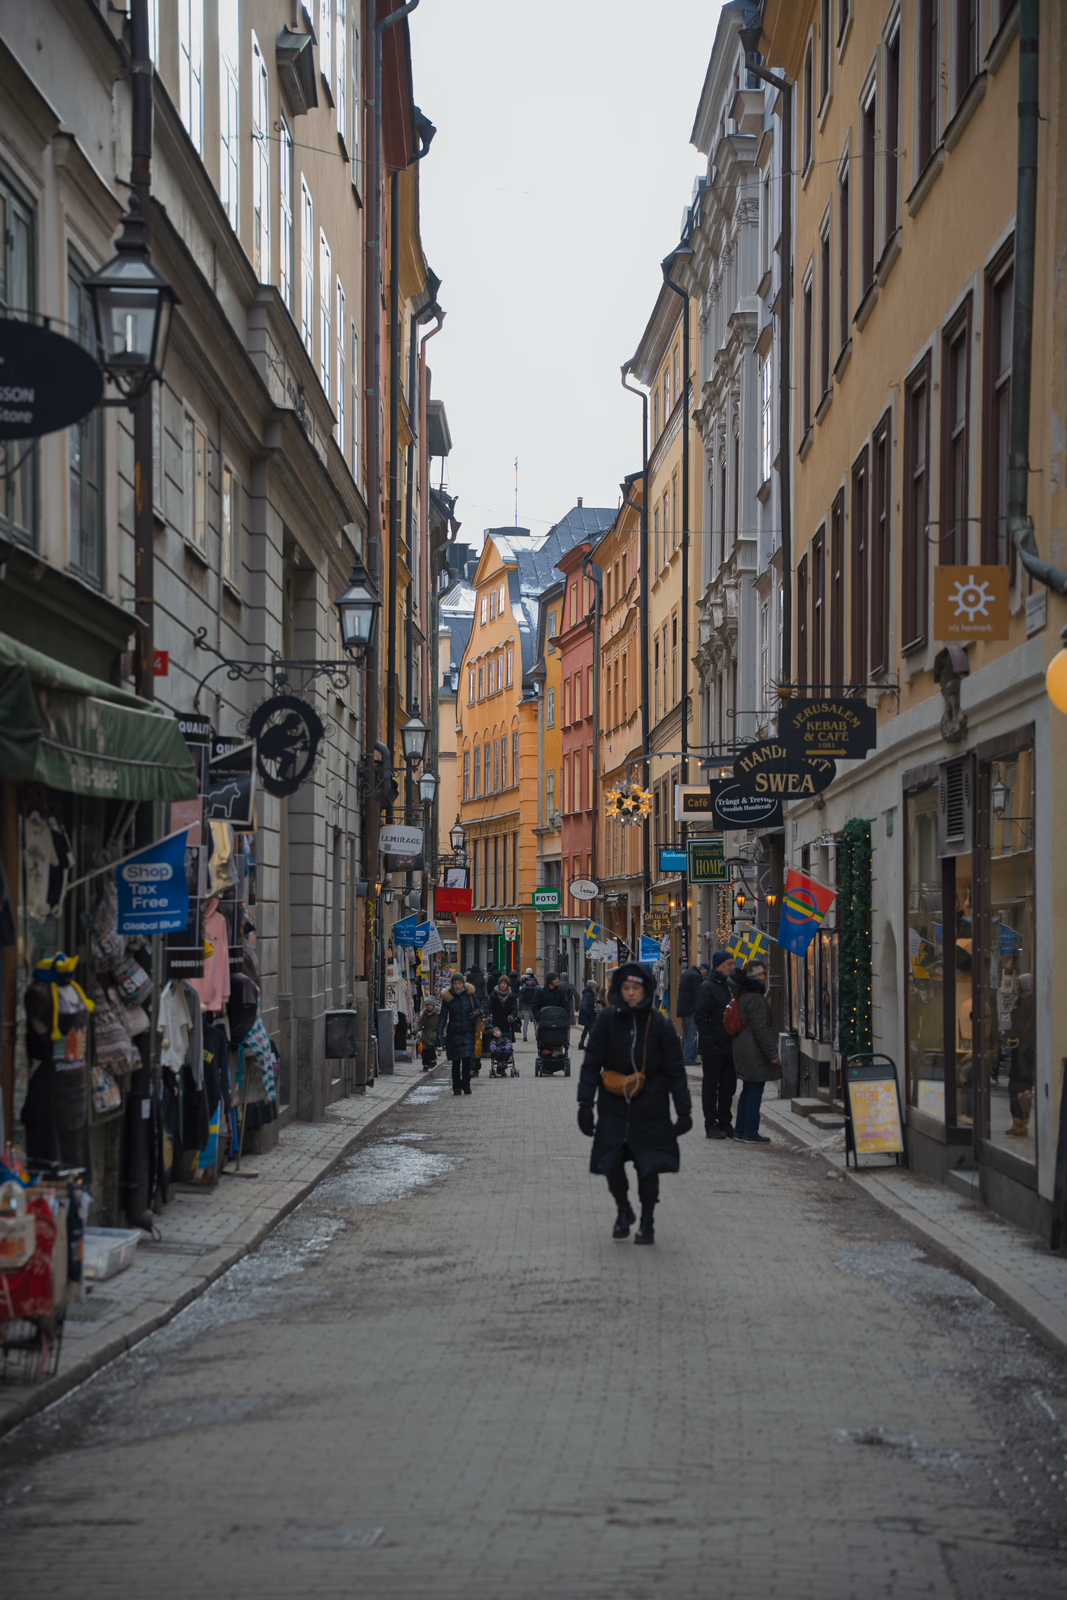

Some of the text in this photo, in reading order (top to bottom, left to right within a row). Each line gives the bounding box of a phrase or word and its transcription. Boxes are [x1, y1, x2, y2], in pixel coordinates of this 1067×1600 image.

[792, 703, 861, 729] JERUSALEM
[806, 721, 847, 731] KEBAB
[804, 729, 849, 741] & CAFÉ
[755, 773, 816, 793] SWEA
[688, 798, 708, 807] Café
[743, 803, 772, 811] Handicraft
[381, 835, 421, 845] LEMIRAGE
[127, 866, 170, 880] Shop
[696, 859, 724, 875] HOME
[128, 883, 157, 895] Tax
[132, 896, 169, 909] Free
[123, 920, 182, 931] Global Blue
